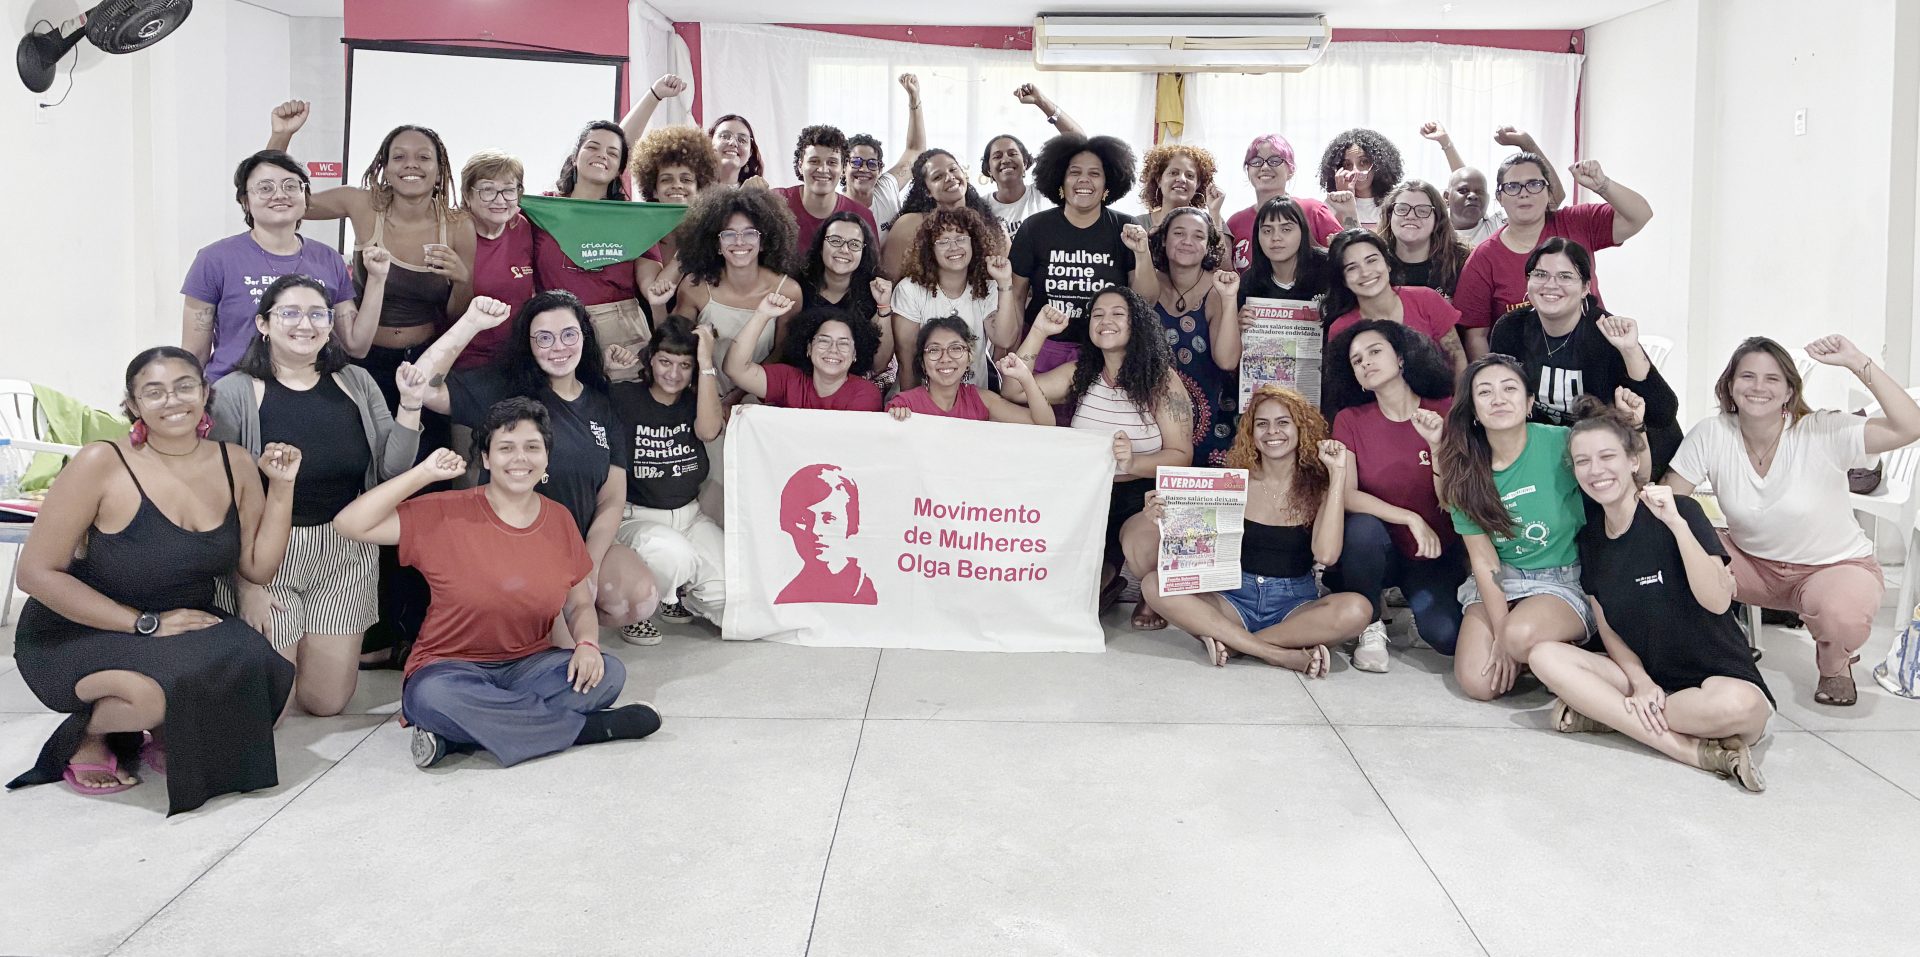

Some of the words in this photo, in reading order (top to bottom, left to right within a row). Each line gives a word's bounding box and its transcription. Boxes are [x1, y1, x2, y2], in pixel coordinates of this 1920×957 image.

[319, 163, 334, 172] WC
[1049, 250, 1114, 267] Mulher,
[1047, 263, 1095, 277] tome
[1255, 308, 1294, 319] VERDADE
[636, 423, 691, 438] Mulher,
[635, 435, 675, 448] tome
[634, 444, 695, 459] partido.
[1161, 477, 1169, 488] A
[1170, 477, 1215, 489] VERDADE
[913, 497, 1041, 524] Movimento
[903, 525, 932, 545] de
[939, 528, 1047, 553] Mulheres
[897, 552, 951, 579] Olga
[957, 559, 1048, 582] Benario
